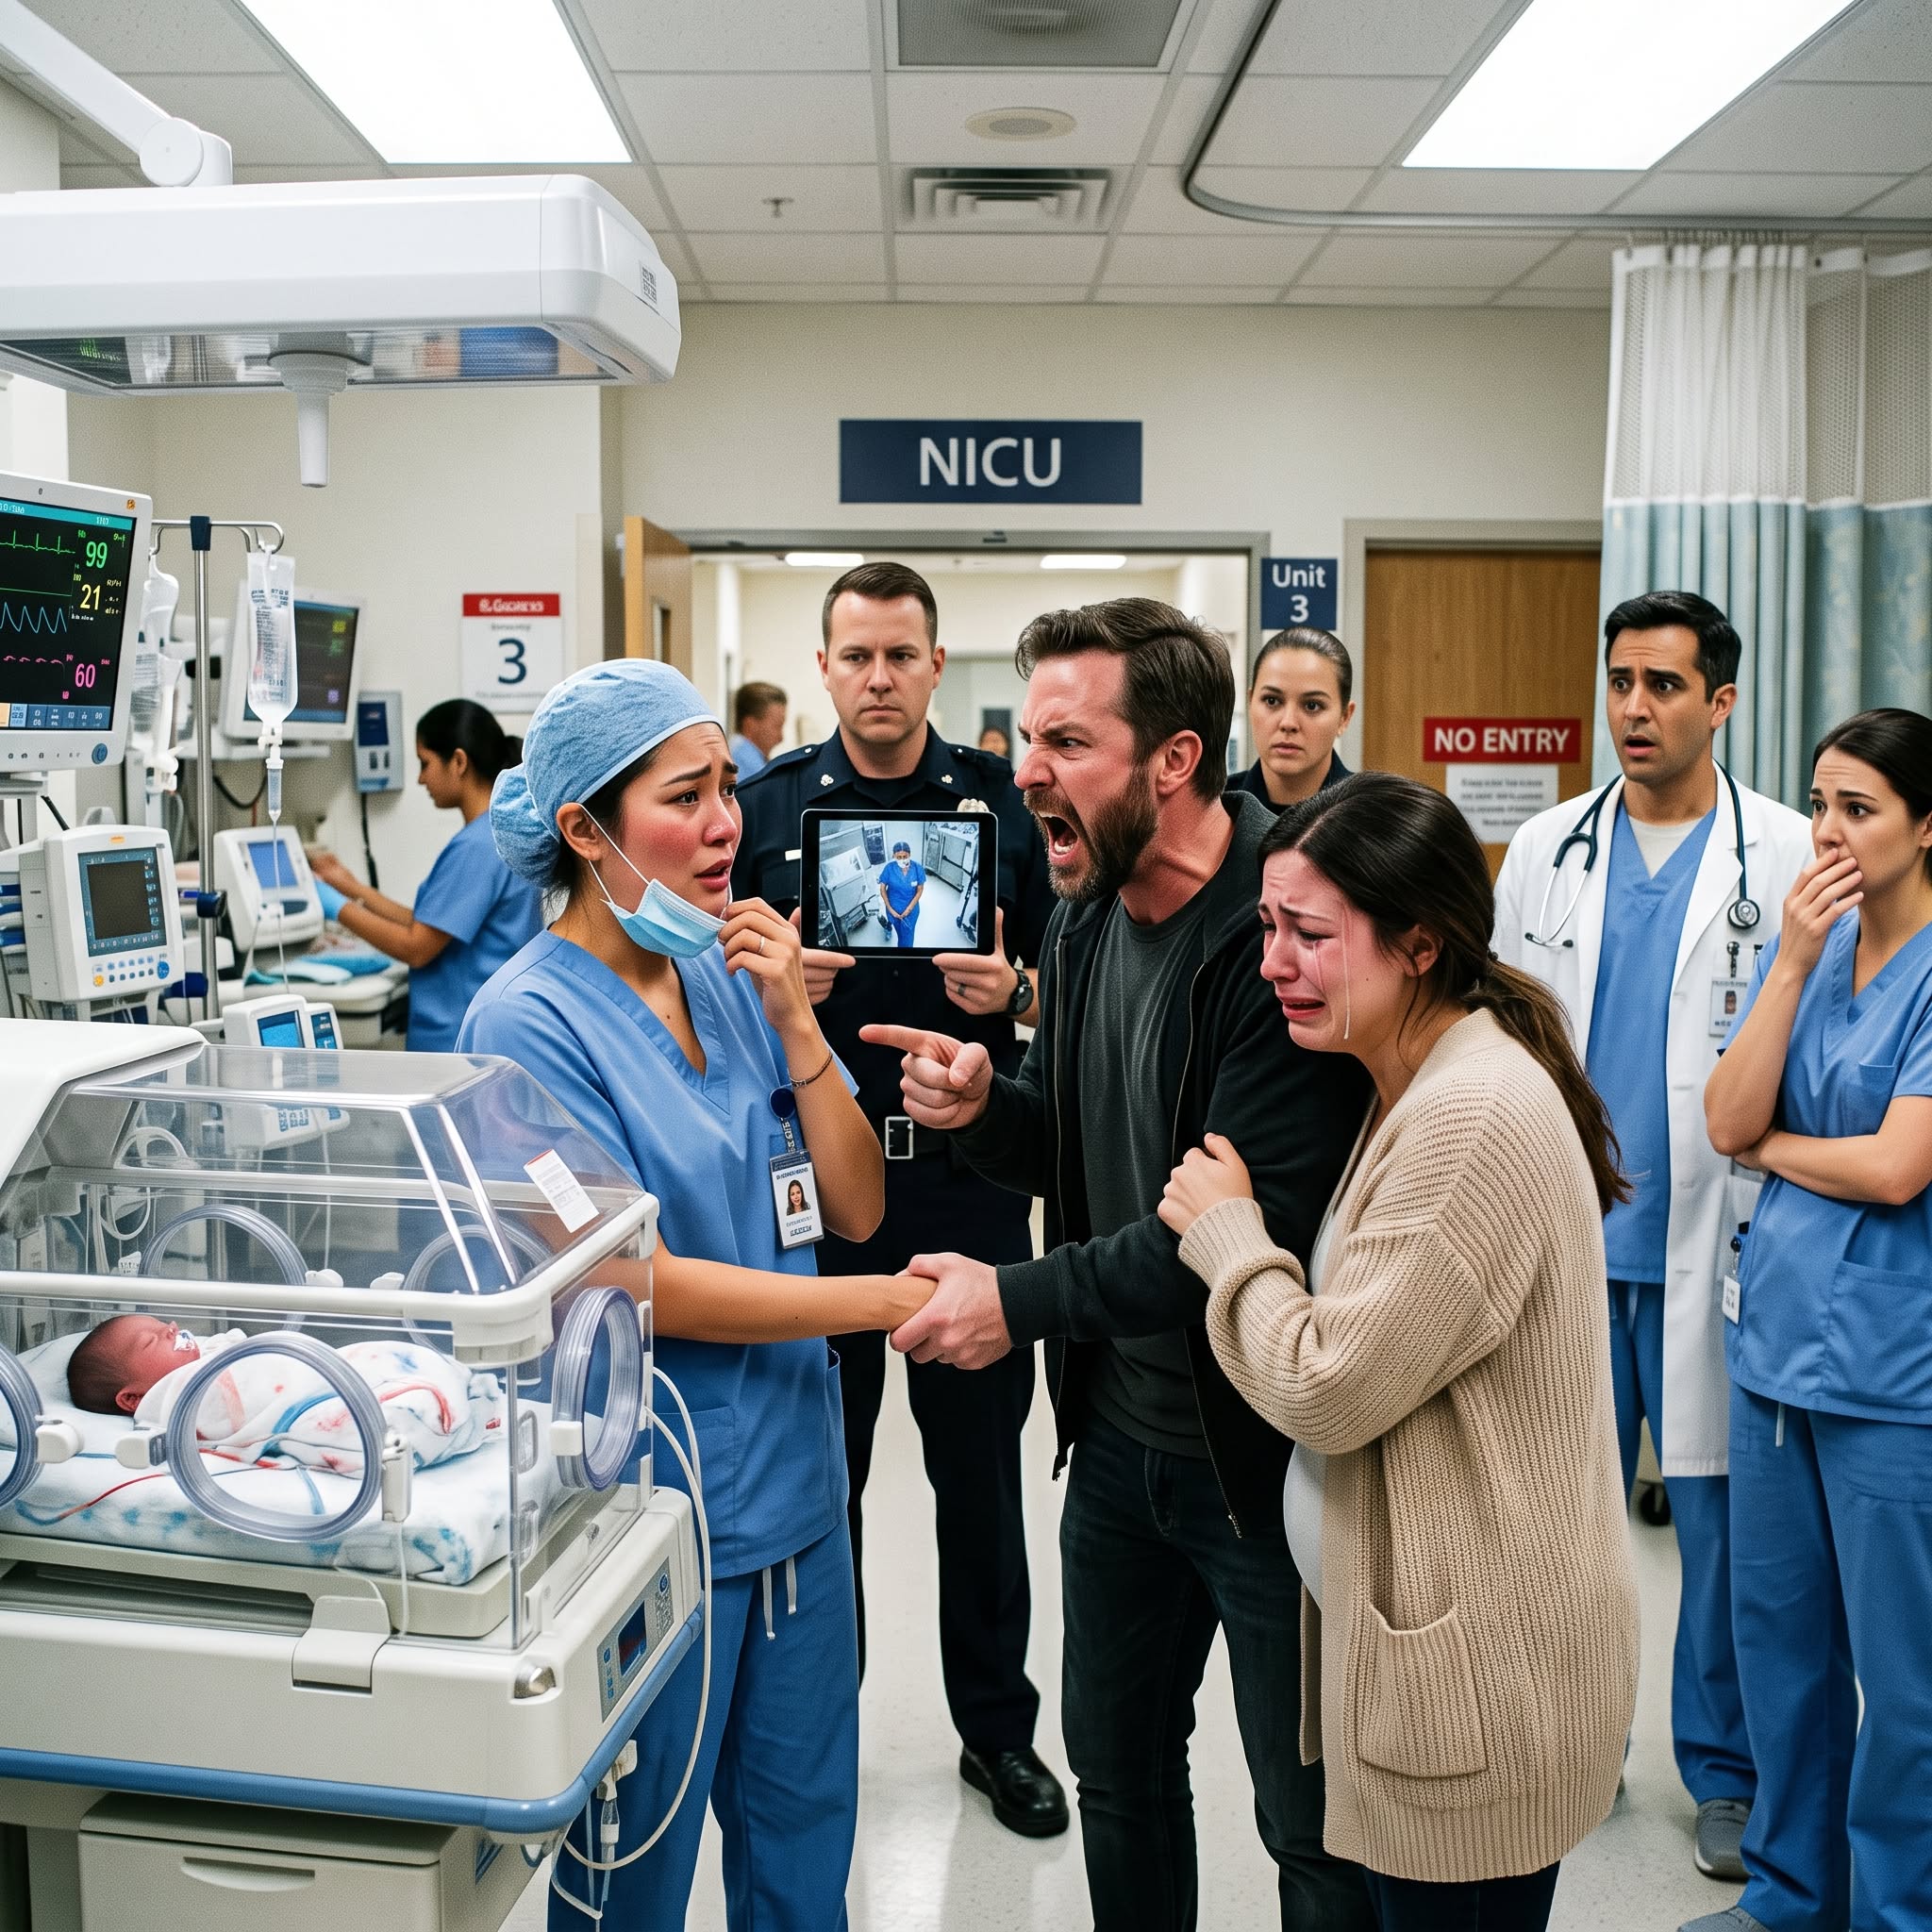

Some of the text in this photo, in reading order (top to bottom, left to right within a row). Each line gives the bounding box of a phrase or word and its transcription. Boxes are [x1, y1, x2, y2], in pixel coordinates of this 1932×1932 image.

[920, 437, 1061, 488] NICU
[86, 541, 108, 569] 99
[1272, 563, 1326, 588] Unit
[79, 583, 101, 610] 21
[1290, 594, 1309, 623] 3
[497, 637, 527, 685] 3
[75, 662, 96, 689] 60
[1434, 726, 1571, 754] NO ENTRY
